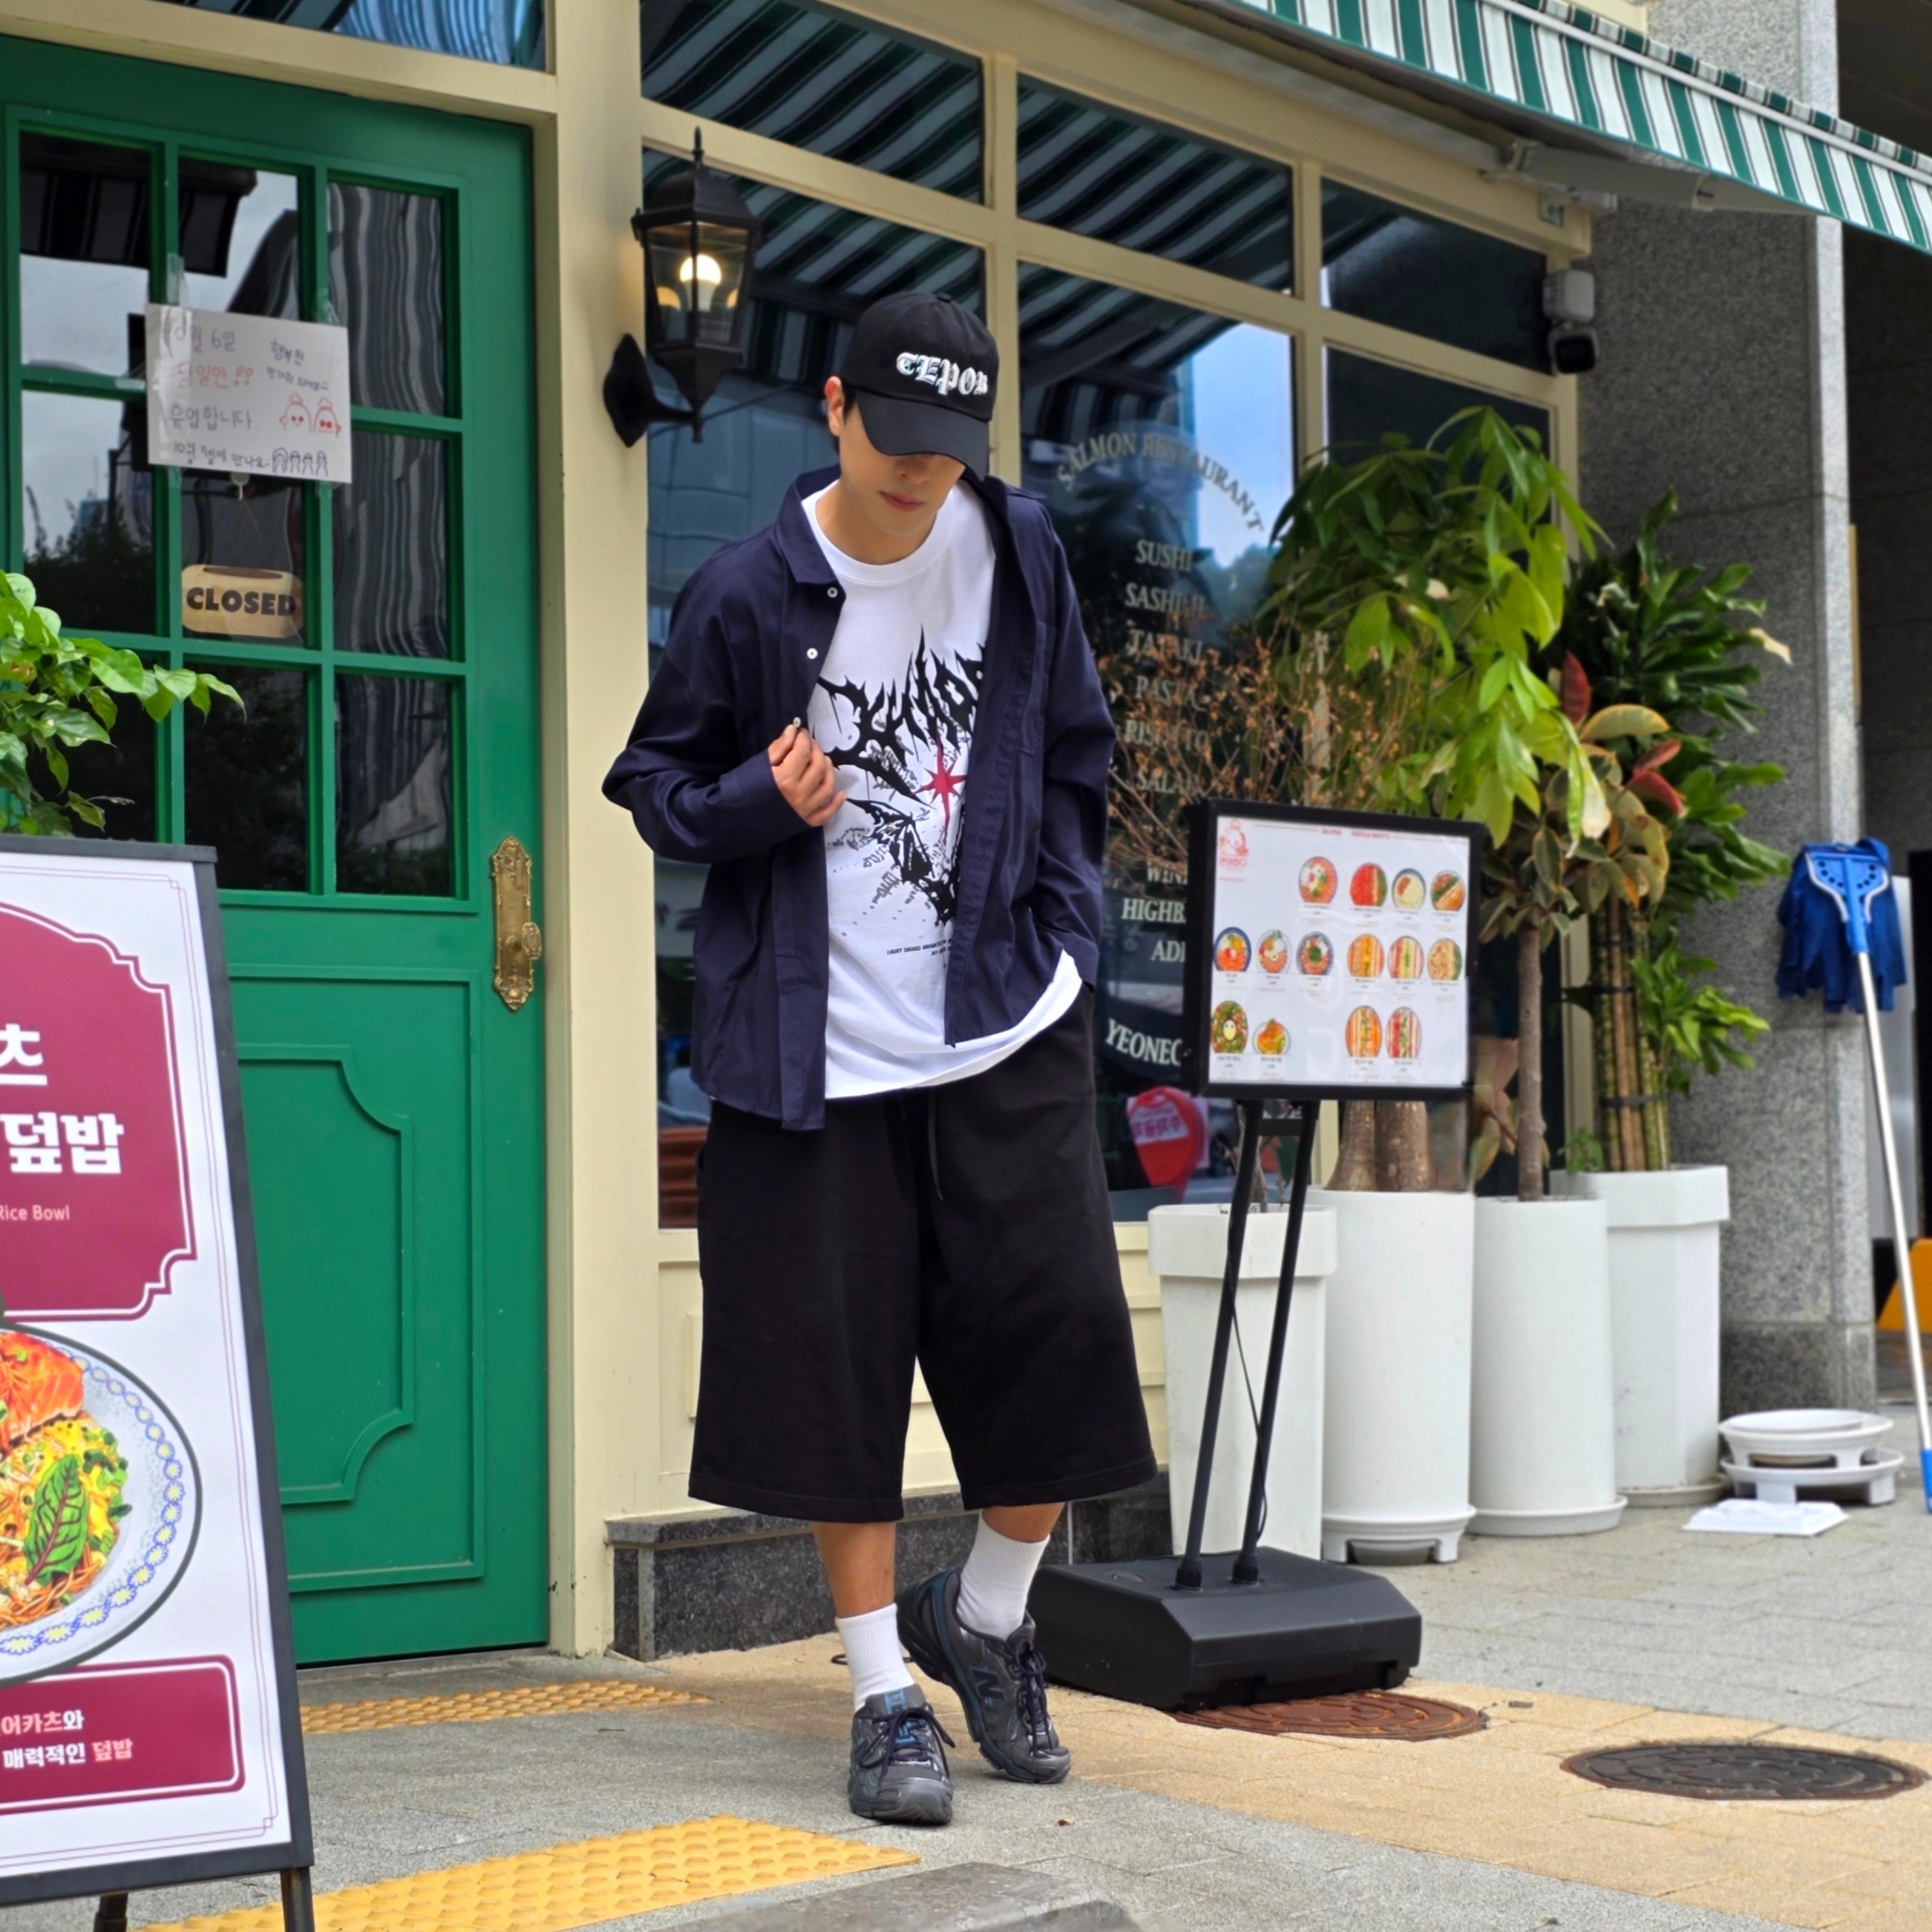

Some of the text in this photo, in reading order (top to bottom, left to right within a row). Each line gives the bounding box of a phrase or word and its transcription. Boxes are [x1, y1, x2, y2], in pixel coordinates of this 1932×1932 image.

[163, 324, 236, 353] 0월 6일
[1057, 432, 1136, 492] SALMON
[1135, 539, 1193, 572] SUSHI
[186, 587, 297, 616] CLOSED
[1135, 675, 1207, 711] PASA
[1124, 719, 1209, 751] RISTO
[1121, 898, 1186, 923] HIGHB
[0, 1111, 124, 1173] 덮밥
[33, 1205, 70, 1220] Bowl
[0, 1710, 84, 1735] 어카츠와
[3, 1738, 133, 1769] 매력적인 덮밥
